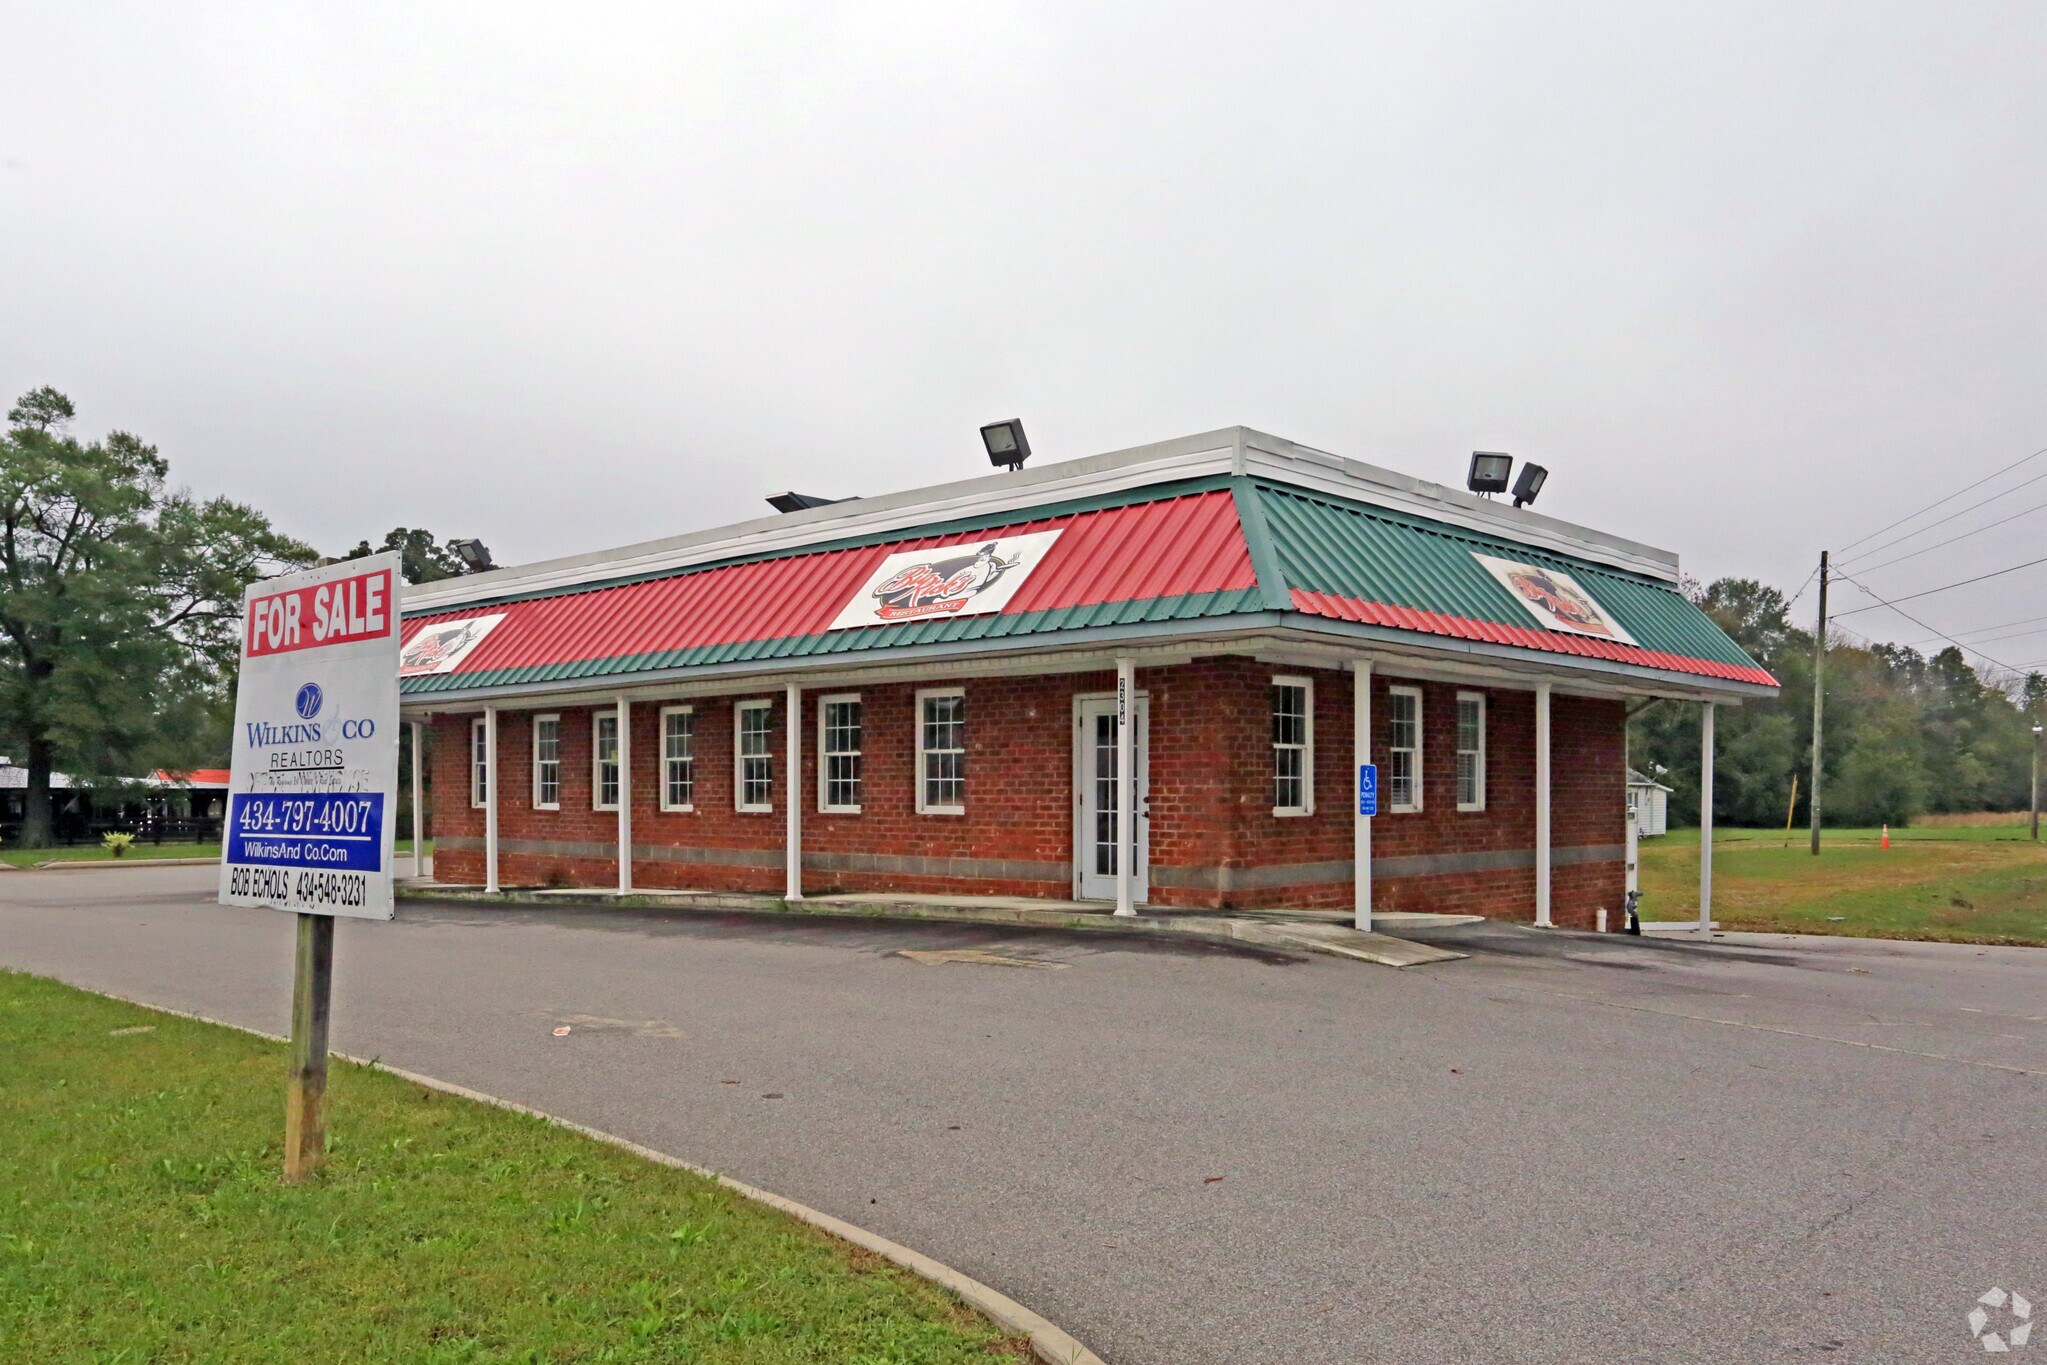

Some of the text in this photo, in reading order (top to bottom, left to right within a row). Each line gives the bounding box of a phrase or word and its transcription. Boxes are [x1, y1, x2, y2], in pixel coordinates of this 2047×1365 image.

[253, 575, 385, 650] FOR SALE
[889, 602, 960, 617] RESTAURANT
[342, 719, 375, 740] CO
[270, 749, 344, 768] REALTORS
[239, 800, 372, 833] 434-797-4007
[244, 841, 348, 862] WilkinsAnd Co.Com
[230, 867, 366, 907] BOB ECHOLS 434-548-3231
